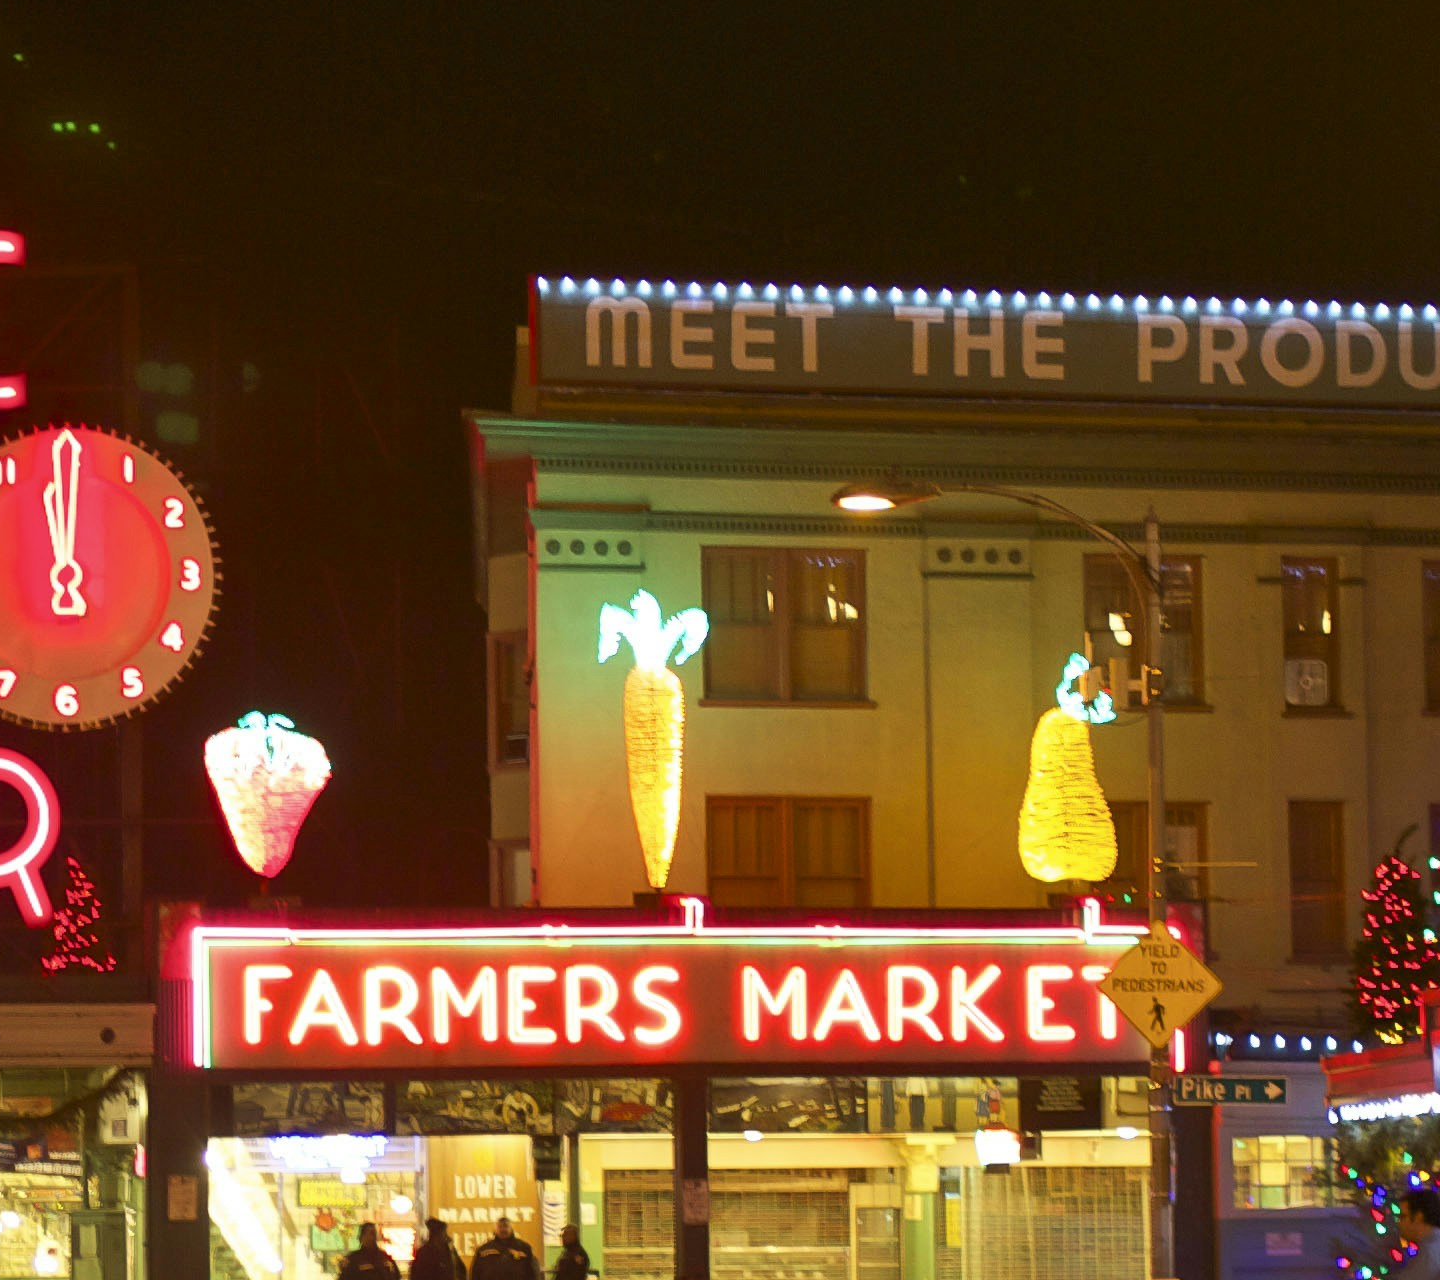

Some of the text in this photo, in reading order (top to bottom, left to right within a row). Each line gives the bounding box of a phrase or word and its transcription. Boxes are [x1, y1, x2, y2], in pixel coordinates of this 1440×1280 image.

[584, 294, 835, 373] MEET
[892, 304, 1067, 382] THE
[122, 454, 135, 484] 1
[163, 497, 185, 529] 2
[179, 558, 202, 593] 3
[160, 621, 185, 653] 4
[121, 666, 144, 699] 5
[53, 684, 80, 717] 6
[1140, 943, 1180, 959] YIELD
[1150, 961, 1168, 976] TO
[1111, 977, 1207, 994] PEDESTRIANS
[240, 962, 684, 1049] FARMERS
[1181, 1077, 1252, 1102] Pike Pl
[453, 1174, 518, 1200] LOWER
[438, 1206, 536, 1224] MARKET
